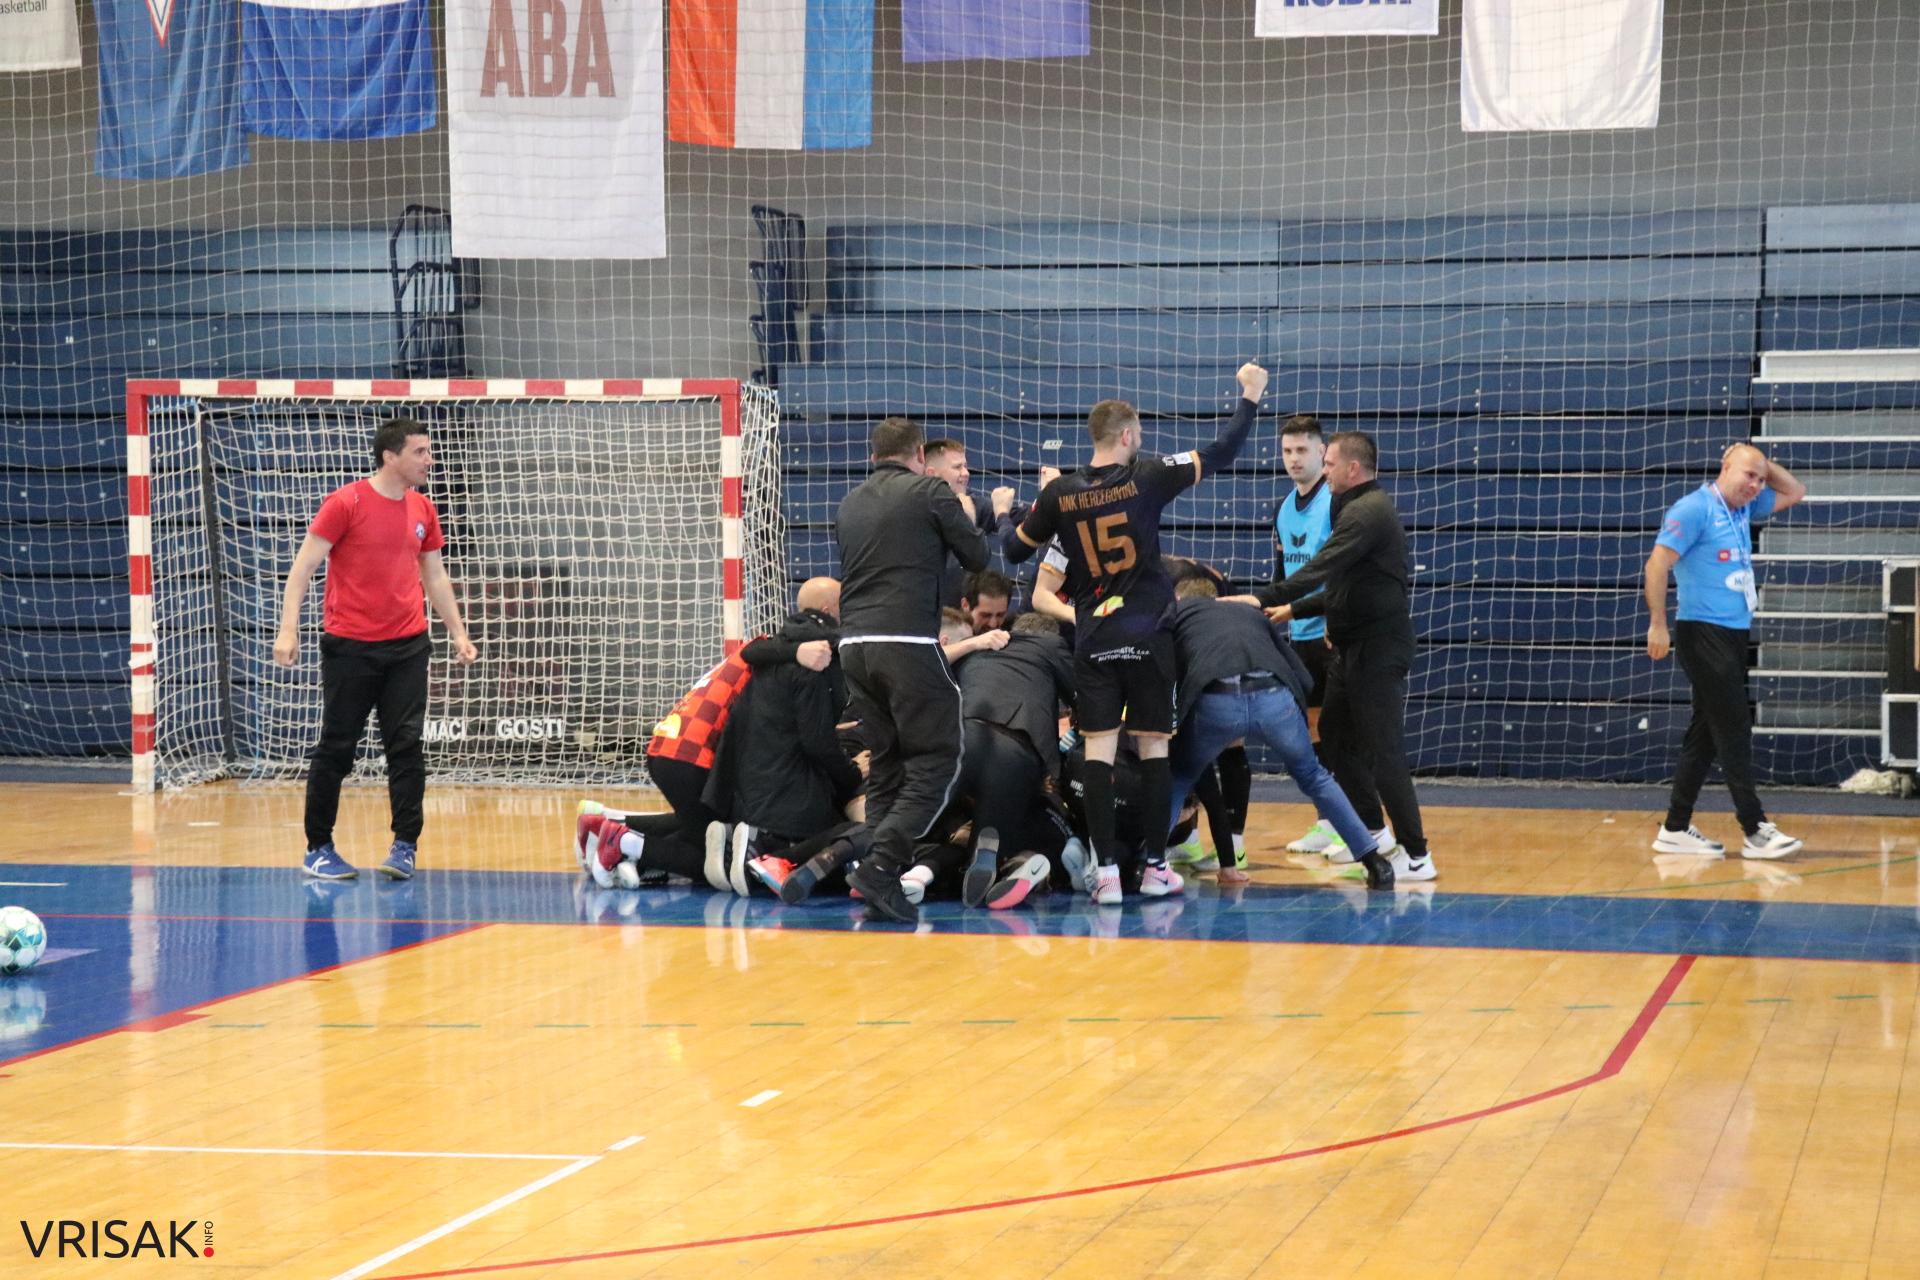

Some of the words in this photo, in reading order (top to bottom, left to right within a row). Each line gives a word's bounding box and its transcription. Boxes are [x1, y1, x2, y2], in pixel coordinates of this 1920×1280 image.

[480, 0, 616, 98] ABA
[1078, 481, 1139, 510] HERCEGOVINA
[1076, 511, 1137, 577] 15
[497, 718, 563, 739] GOSTI
